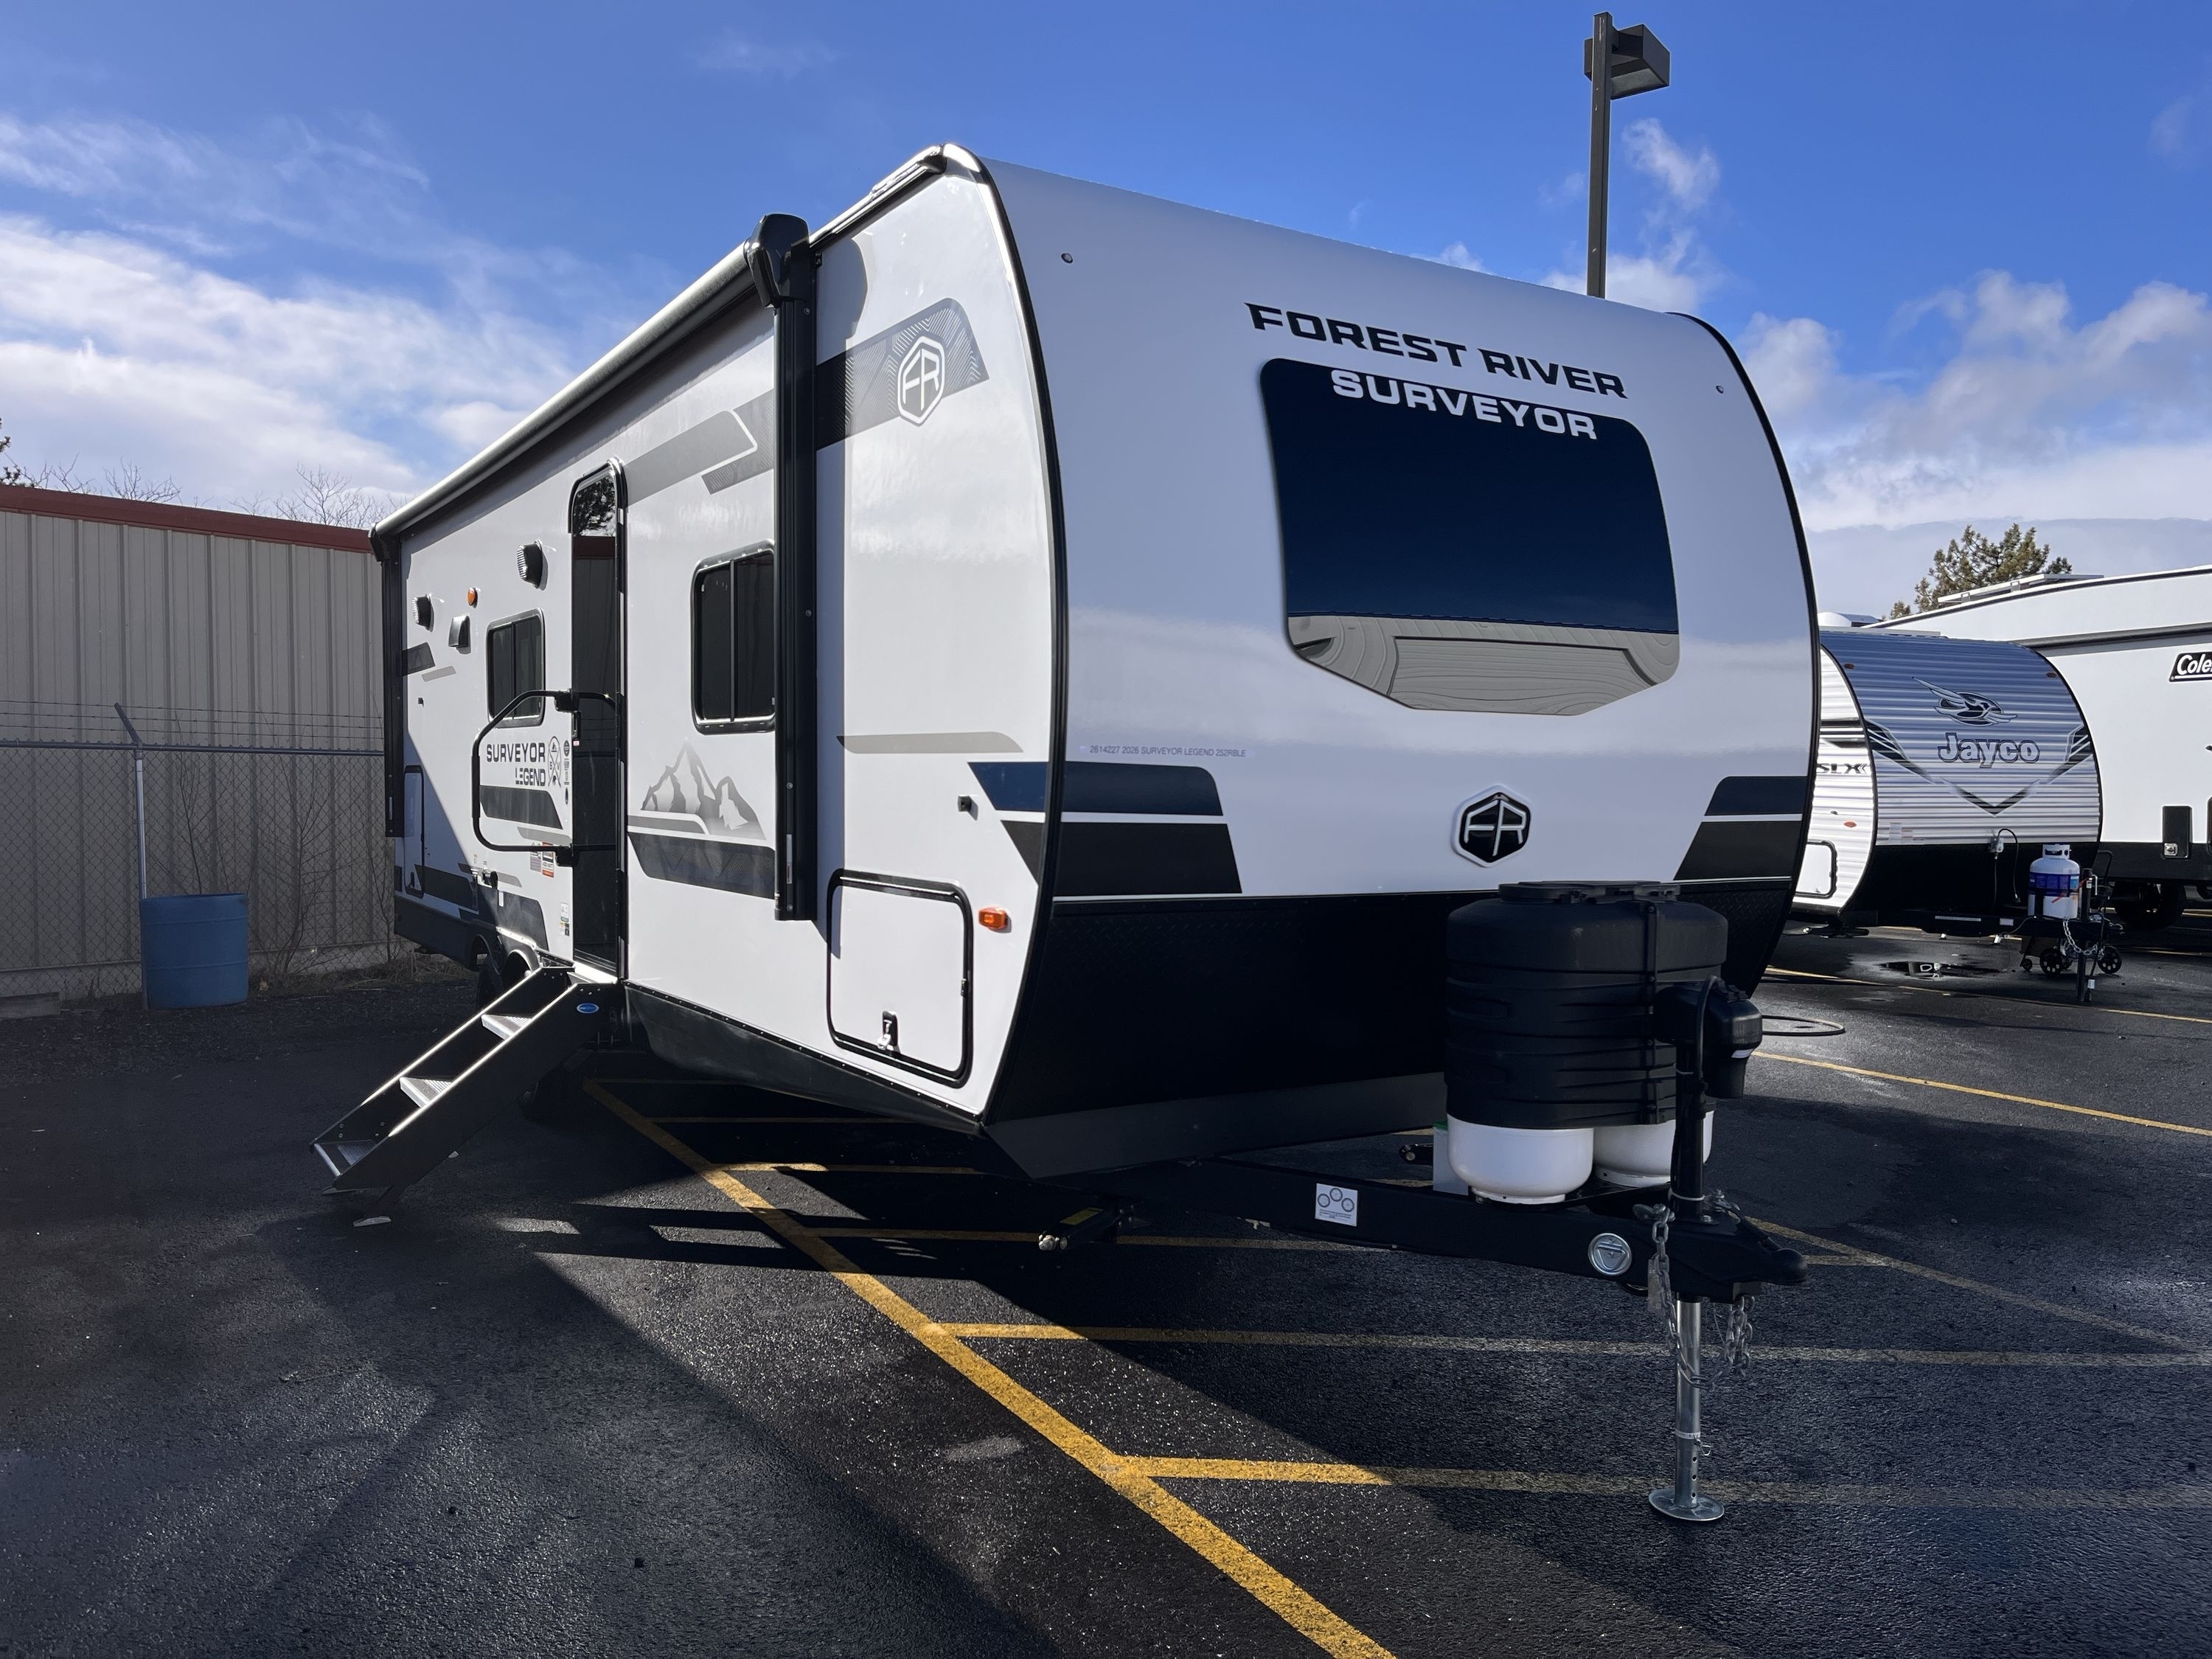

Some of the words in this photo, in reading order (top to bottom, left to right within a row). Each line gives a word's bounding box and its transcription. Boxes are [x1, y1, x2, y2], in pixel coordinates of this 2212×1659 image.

[1243, 302, 1467, 367] FOREST
[1477, 348, 1629, 399] RIVER
[1331, 369, 1598, 440] SURVEYOR
[2177, 654, 2212, 675] Cole
[487, 742, 546, 762] SURVEYOR
[1121, 745, 1139, 754] 2026
[1141, 746, 1182, 755] SURVEYOR
[1183, 748, 1214, 757] LEGEND
[1938, 733, 2040, 768] Jayco
[515, 768, 546, 787] LEGEND
